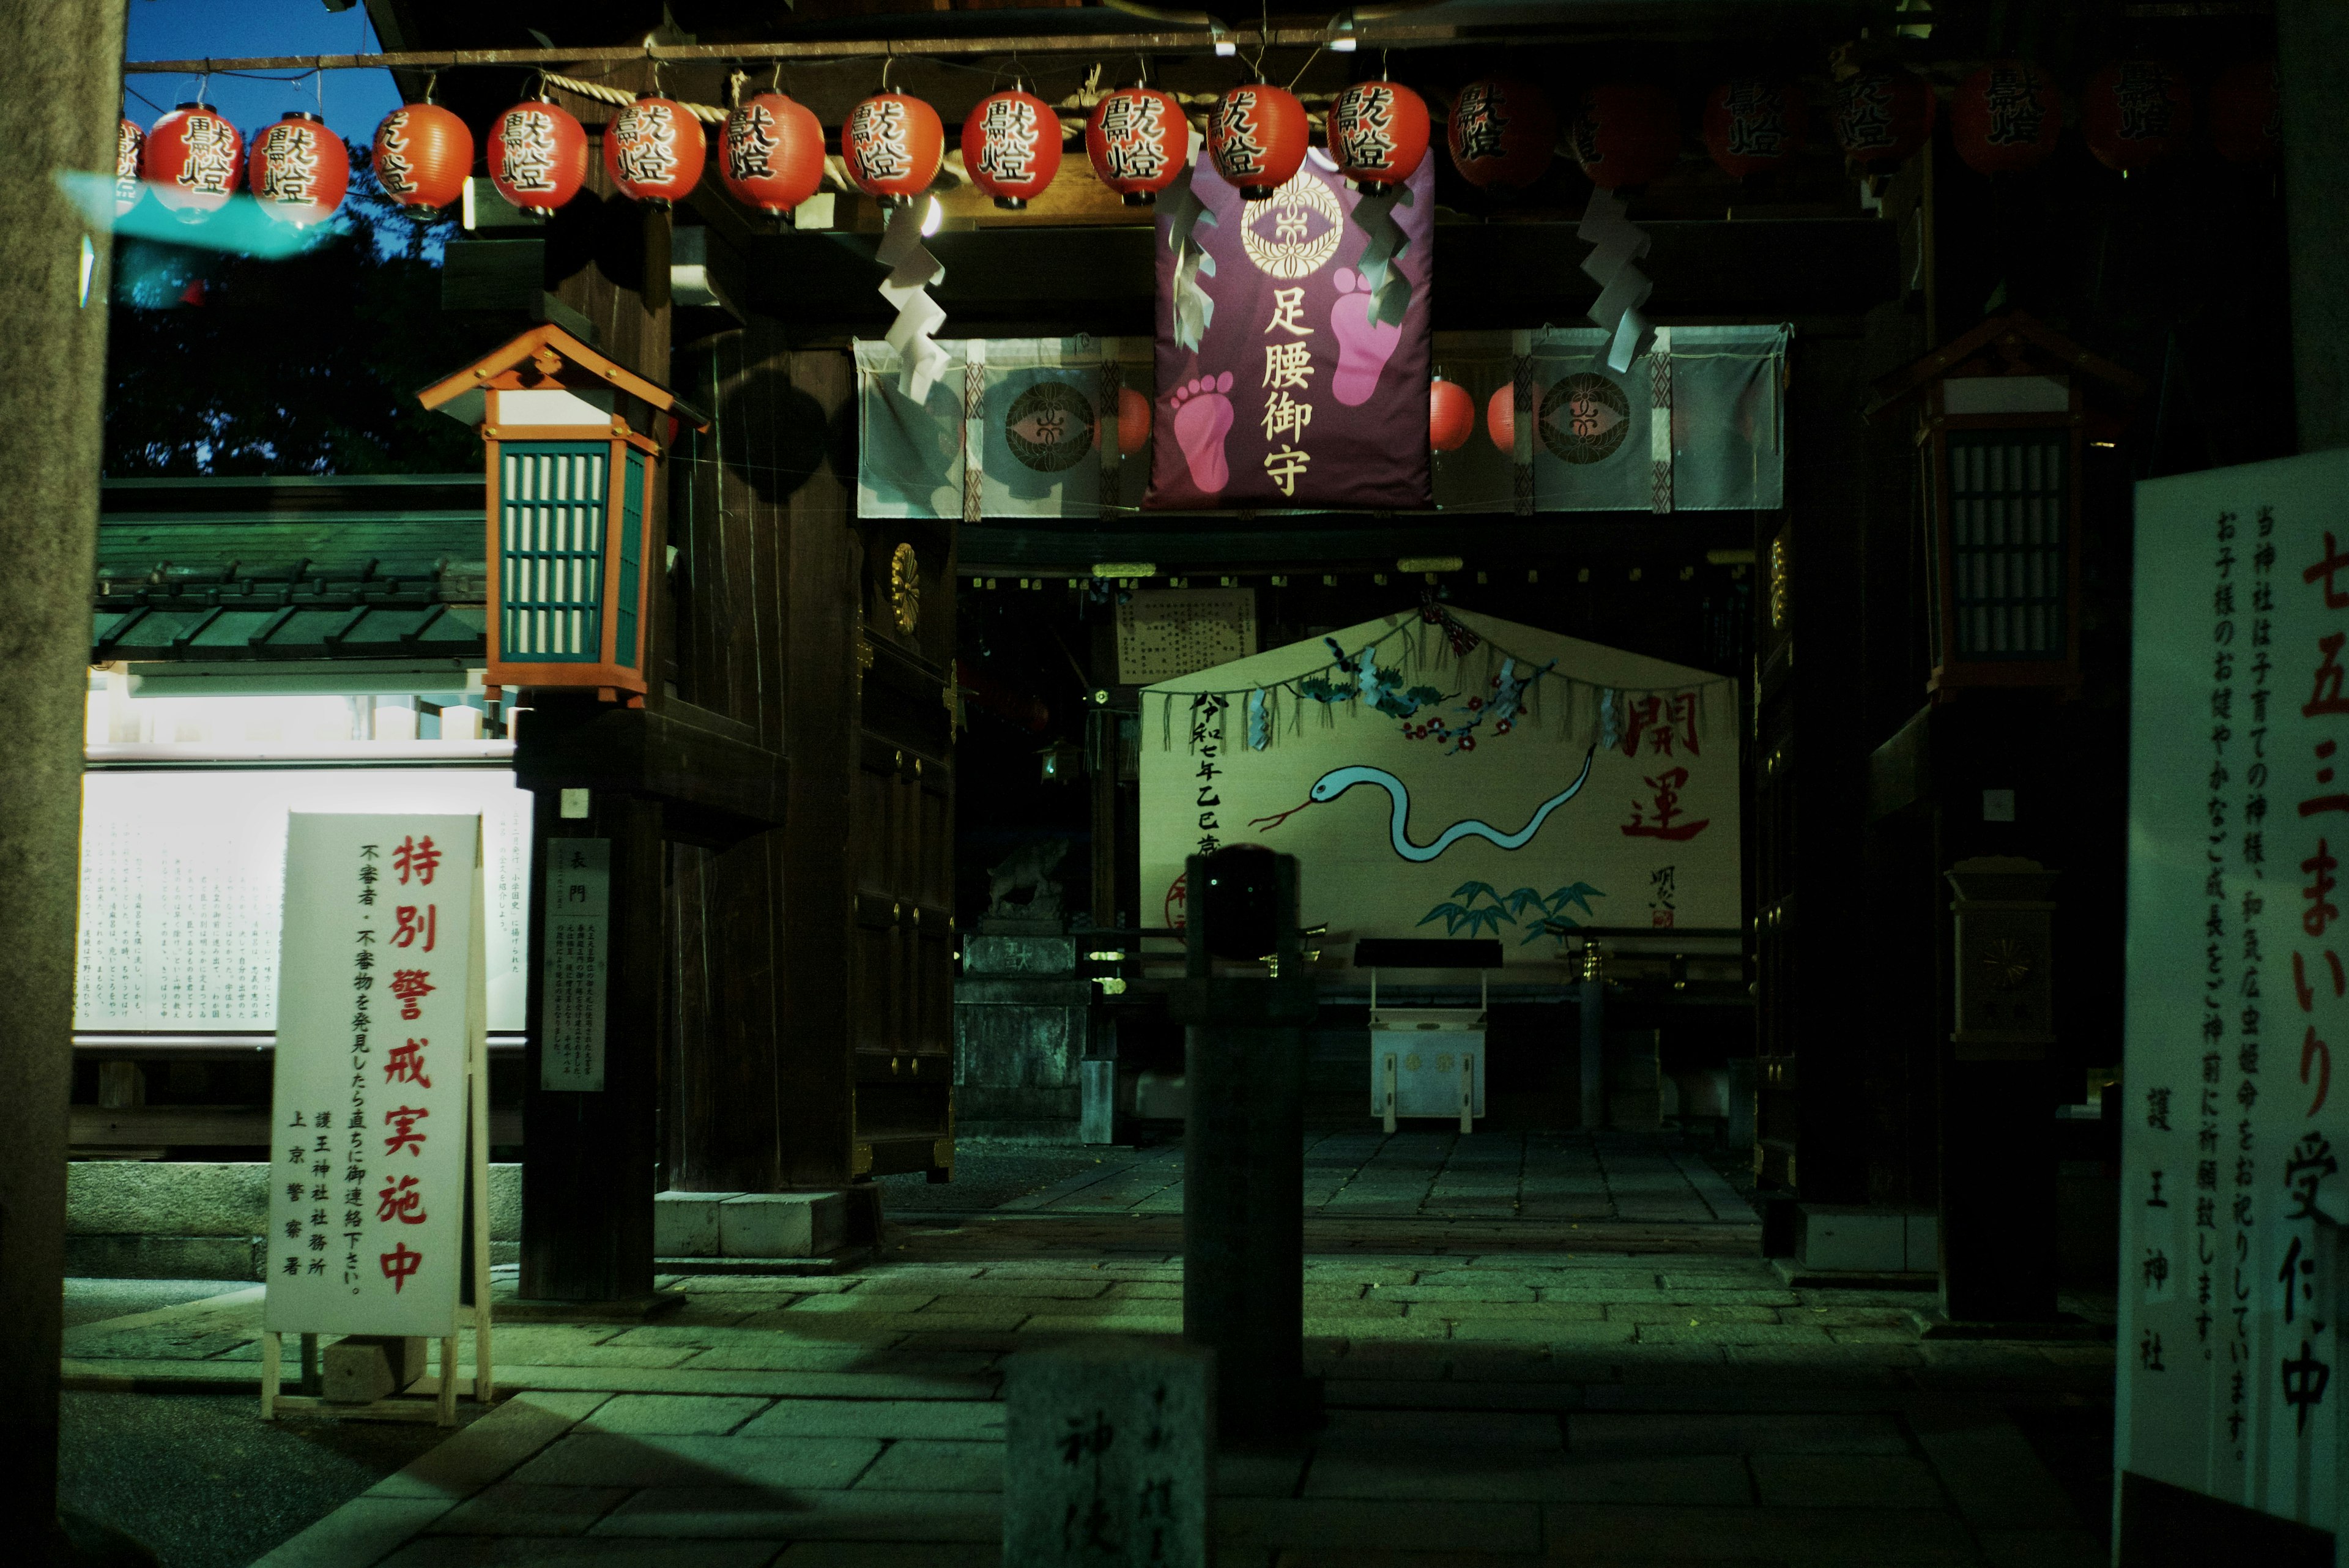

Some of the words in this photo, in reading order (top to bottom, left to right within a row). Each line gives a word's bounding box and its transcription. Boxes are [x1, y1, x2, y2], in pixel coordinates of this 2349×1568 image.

[1261, 286, 1315, 497] 足腰御守
[1189, 690, 1229, 857] 令和七年乙巳歳
[1621, 692, 1709, 840] 開運
[569, 850, 588, 904] 表門
[343, 844, 379, 1296] 不審者・不審物を発見したら直ちに御連絡下さい。
[377, 835, 442, 1295] 特別警戒実施中
[283, 1110, 307, 1276] 上京警察署
[307, 1110, 332, 1276] 護王神社社務所
